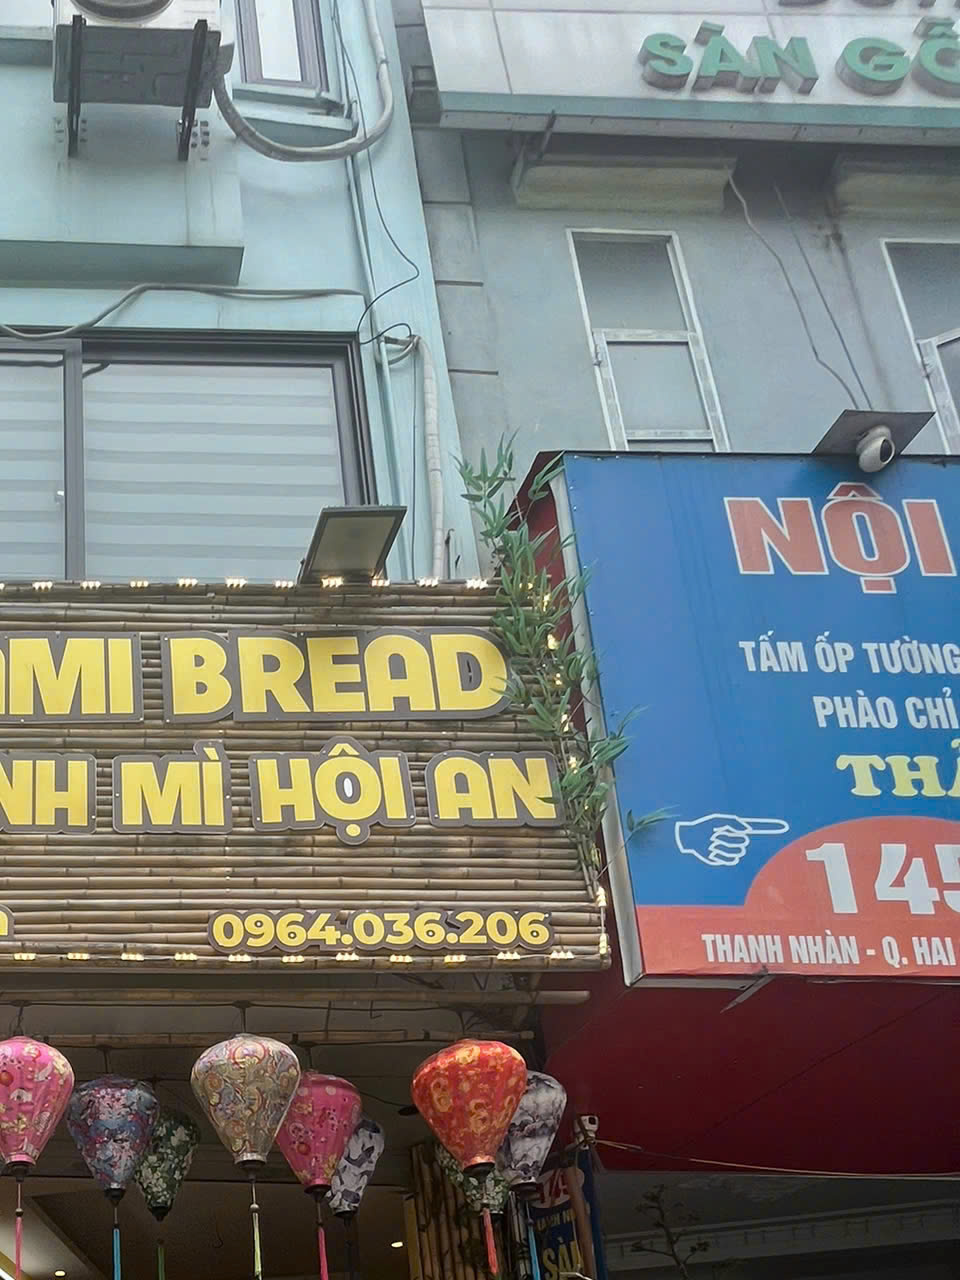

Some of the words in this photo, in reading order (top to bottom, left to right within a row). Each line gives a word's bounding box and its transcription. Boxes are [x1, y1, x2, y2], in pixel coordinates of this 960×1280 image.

[637, 20, 818, 95] SÀN
[724, 482, 958, 594] NỘI
[169, 633, 509, 716] BREAD
[739, 631, 809, 673] TẤM
[814, 631, 855, 673] ỐP
[862, 634, 960, 674] TƯỜNG
[813, 689, 898, 729] PHÀO
[906, 687, 959, 729] CHỈ
[121, 747, 226, 826] MÌ
[256, 743, 409, 838] HỘI
[434, 755, 558, 821] AN
[836, 738, 960, 797] TH
[212, 910, 551, 948] 0964.036.206
[702, 933, 784, 965] THANH
[789, 929, 860, 965] NHÀN
[882, 936, 908, 968] Q.
[911, 936, 956, 966] HAI
